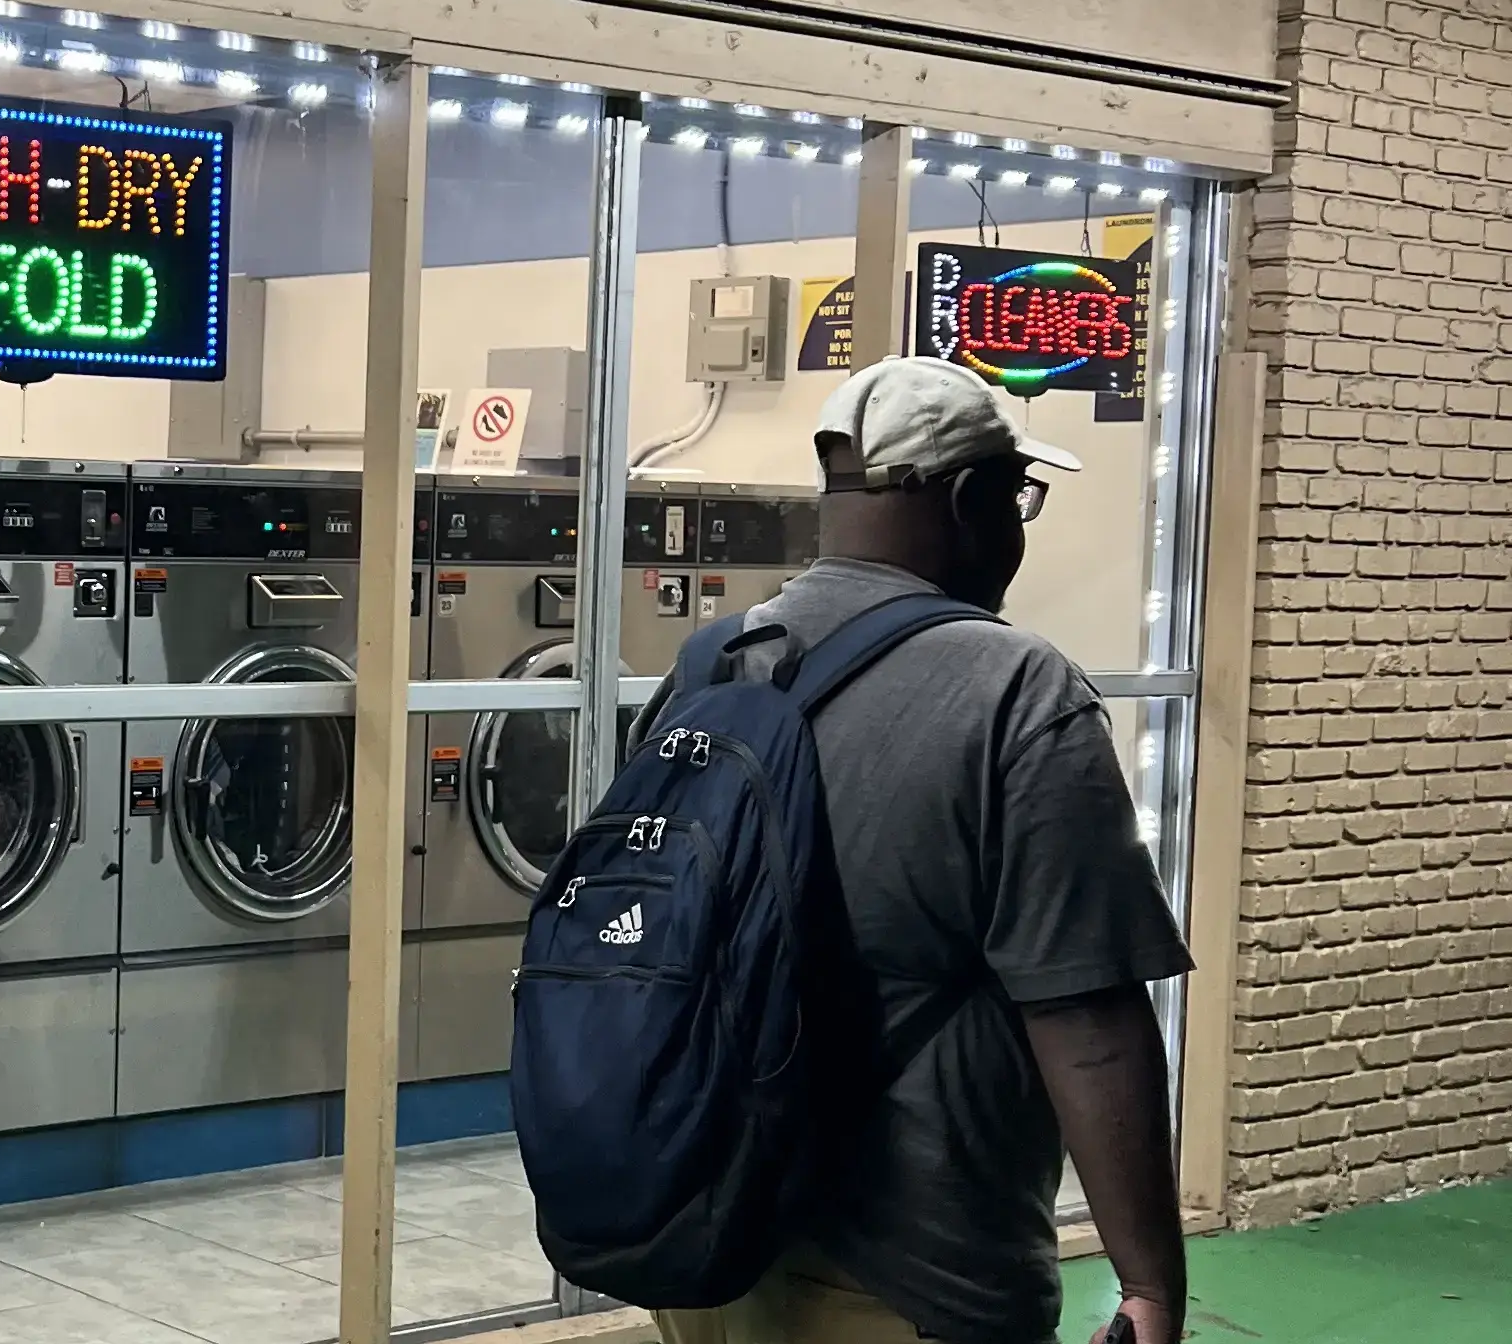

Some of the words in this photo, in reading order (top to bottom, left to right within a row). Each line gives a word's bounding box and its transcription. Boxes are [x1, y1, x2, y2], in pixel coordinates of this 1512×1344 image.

[819, 305, 836, 316] NOT
[837, 305, 850, 316] SIT
[267, 549, 306, 558] DEXTER
[441, 601, 452, 611] 23
[702, 602, 712, 612] 24
